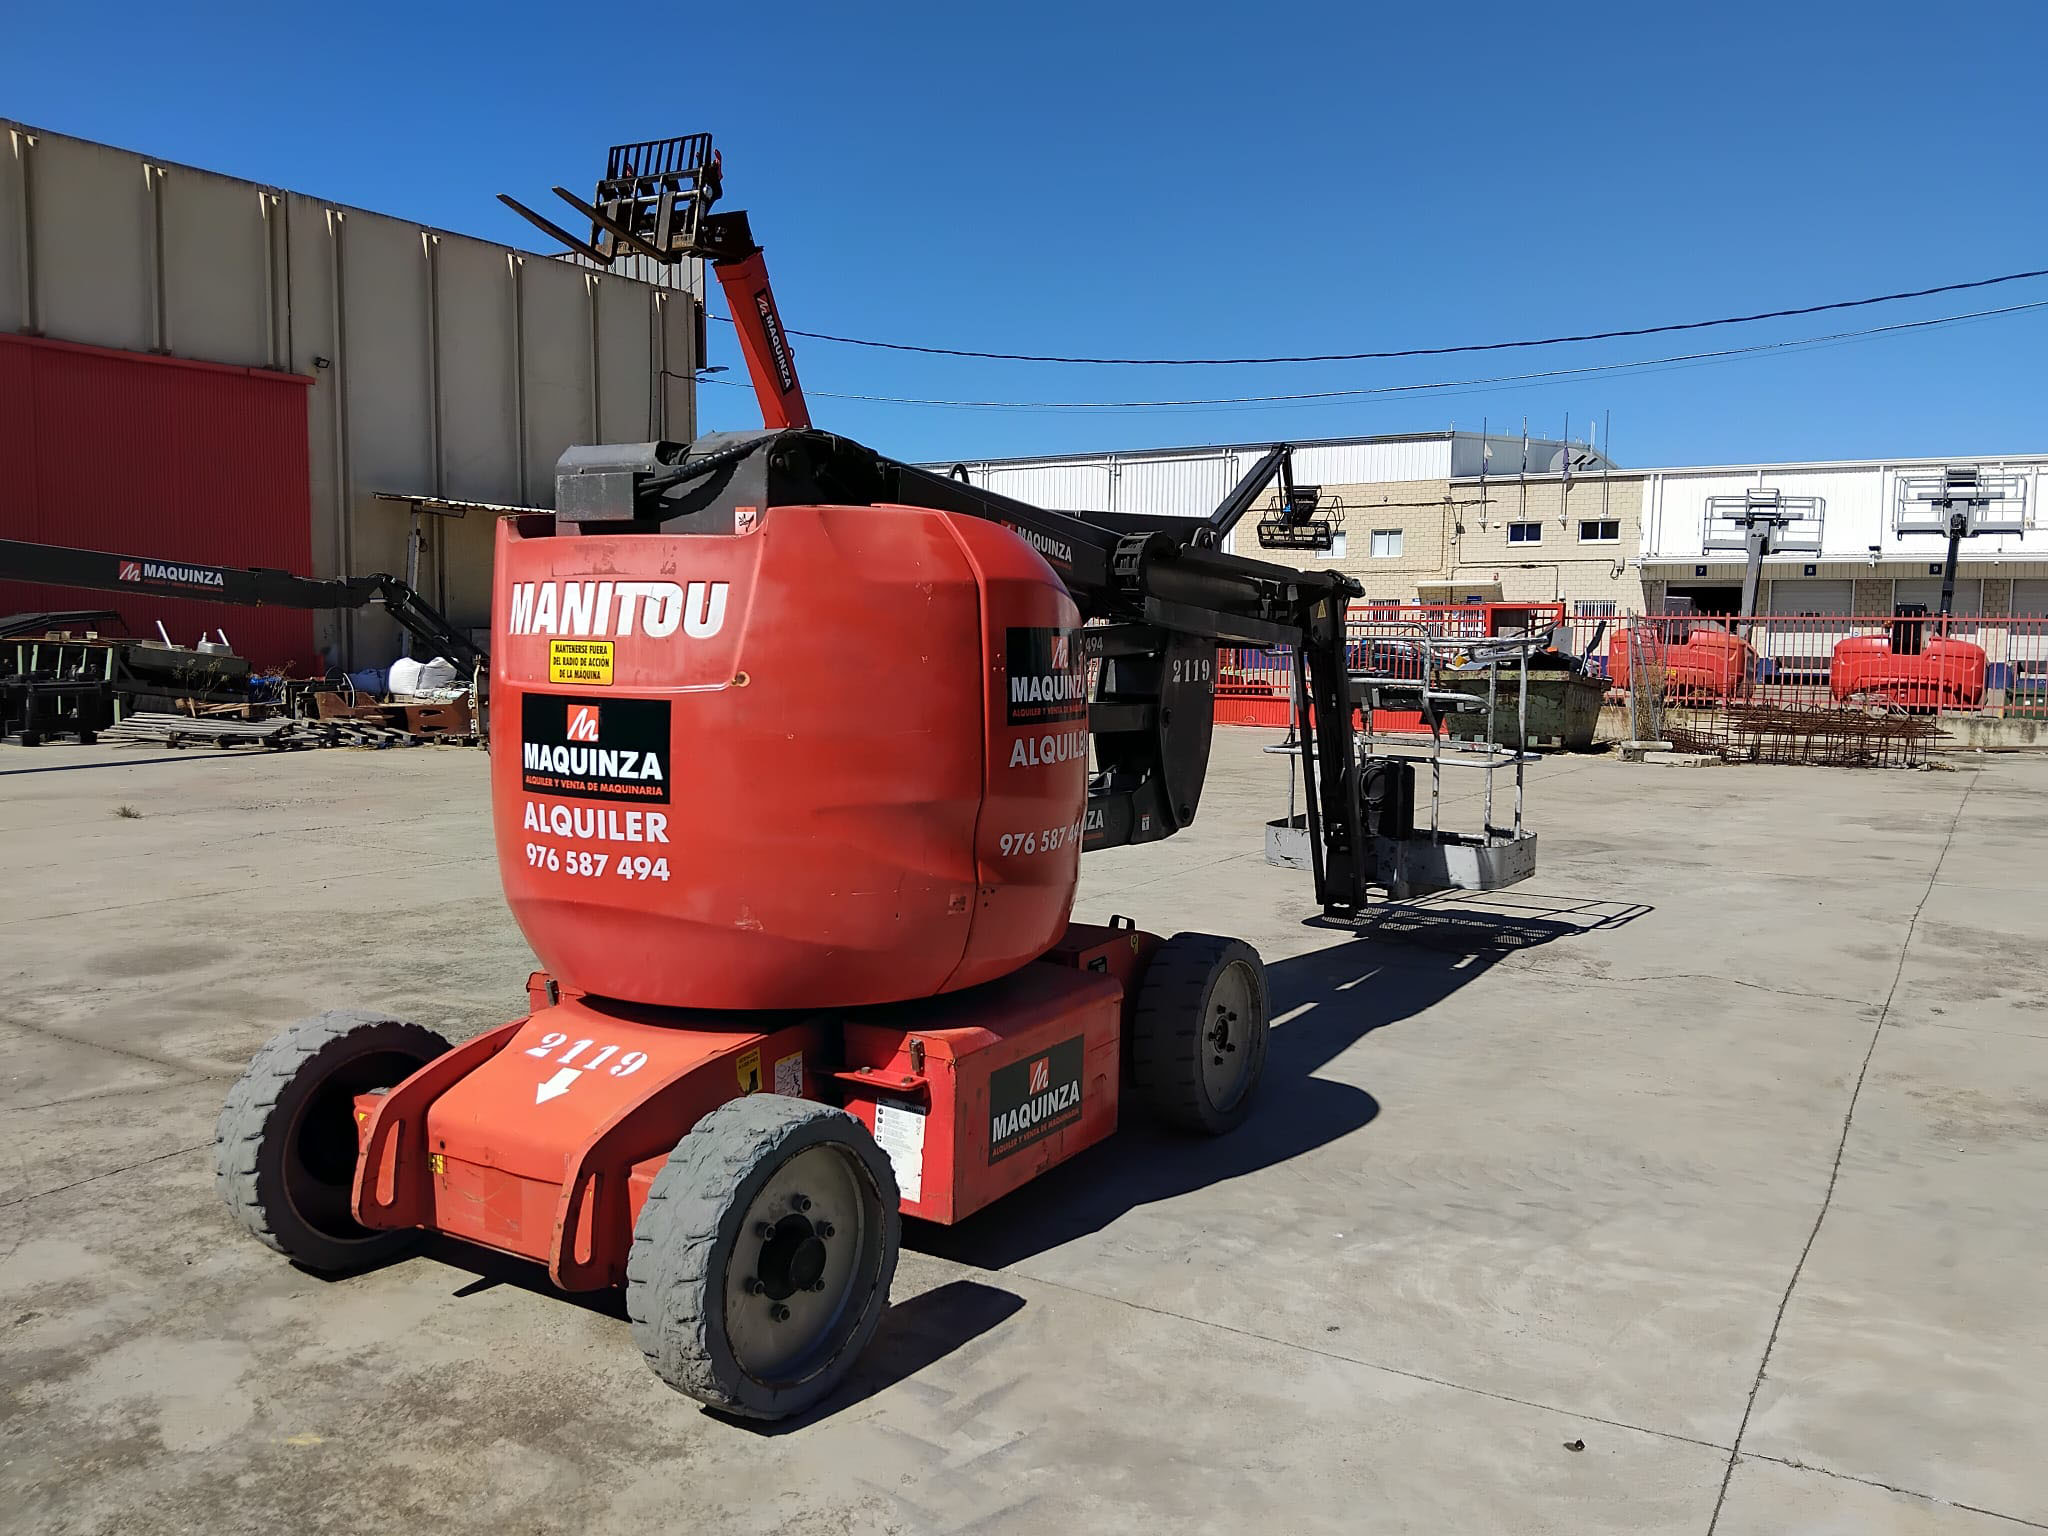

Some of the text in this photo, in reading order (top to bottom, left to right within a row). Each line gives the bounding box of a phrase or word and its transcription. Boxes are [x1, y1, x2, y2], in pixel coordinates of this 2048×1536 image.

[766, 314, 792, 388] MAQUINZA
[1017, 526, 1072, 562] MAQUINZA
[144, 563, 224, 586] MAQUINZA
[509, 581, 729, 638] MANITOU
[553, 656, 561, 666] DEL
[562, 657, 579, 666] RADIO
[580, 657, 587, 667] DE
[555, 644, 608, 655] MANTENERSE FUERA
[1085, 636, 1104, 653] 494
[559, 669, 566, 679] DE
[567, 669, 573, 679] LA
[1172, 659, 1211, 683] 2119
[524, 742, 664, 781] MAQUINZA
[1009, 729, 1088, 768] ALQUILE
[525, 775, 664, 796] ALQUILER Y VENTA DE MAQUINARIA
[524, 801, 670, 843] ALQUILER
[1000, 821, 1084, 857] 976 587 49
[526, 842, 671, 881] 976 587 494
[524, 1031, 649, 1078] 2119
[992, 1080, 1080, 1143] MAQUINZA
